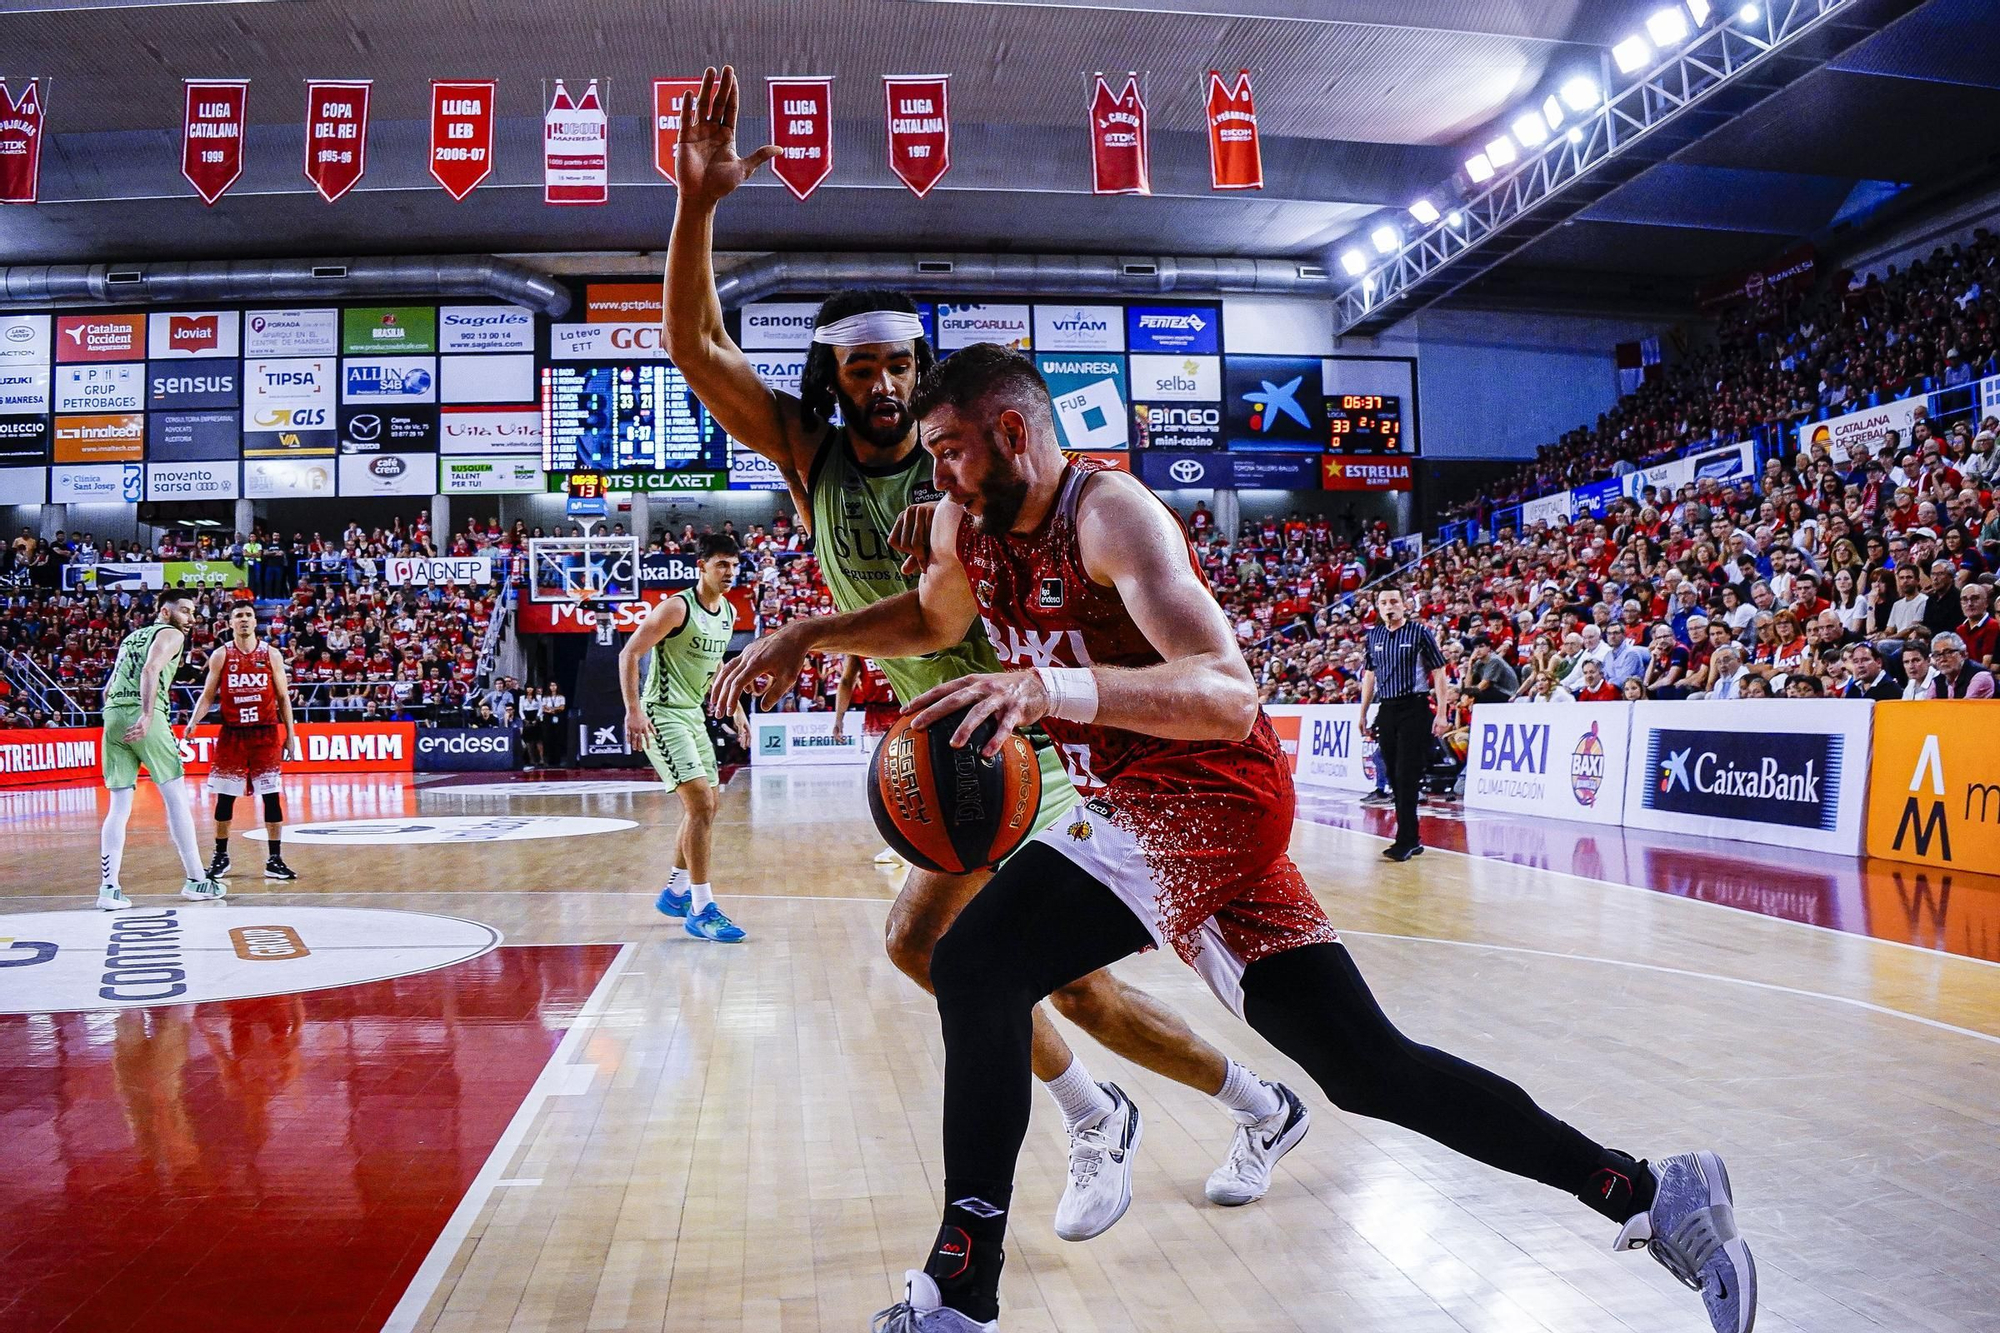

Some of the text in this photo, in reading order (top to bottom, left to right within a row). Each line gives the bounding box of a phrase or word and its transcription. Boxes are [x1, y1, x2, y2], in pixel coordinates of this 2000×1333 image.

[21, 103, 35, 114] 10
[199, 103, 230, 118] LLIGA
[322, 103, 352, 118] COPA
[442, 100, 481, 115] LLIGA
[784, 100, 817, 115] LLIGA
[900, 99, 932, 114] LLIGA
[190, 122, 238, 138] CATALANA
[315, 123, 356, 138] DEL REI
[448, 123, 474, 138] LEB
[788, 120, 813, 135] ACB
[892, 118, 943, 134] CATALANA
[3, 141, 27, 149] TDK
[784, 146, 821, 159] 1997-98
[907, 145, 930, 158] 1997
[201, 151, 224, 163] 1999
[435, 147, 486, 161] 2006-07
[444, 314, 529, 327] Sagalés
[1053, 321, 1106, 330] VITAM
[87, 324, 132, 334] Catalana
[174, 328, 212, 340] Joviat
[87, 334, 131, 344] Occident
[572, 342, 592, 352] ETT
[154, 375, 233, 394] sensus
[265, 373, 315, 386] TIPSA
[1156, 376, 1196, 391] selba
[84, 385, 116, 395] GRUP
[5, 396, 44, 404] MANRESA
[63, 397, 136, 408] PETROBAGES
[1060, 395, 1087, 412] FUB
[1343, 395, 1382, 409] 06:37
[292, 409, 325, 426] GLS
[1332, 417, 1399, 434] 33 2 21
[1834, 414, 1891, 437] CATALANA
[1387, 438, 1396, 448] 2
[377, 457, 398, 467] café
[451, 464, 493, 472] BUSQUEM
[154, 470, 212, 481] movento
[374, 466, 400, 474] crem
[1345, 464, 1409, 478] ESTRELLA
[154, 482, 191, 492] sarsa
[647, 473, 715, 488] CLARET
[580, 485, 596, 497] 13
[415, 561, 482, 580] AIGNEP
[227, 672, 268, 688] BAXI
[239, 706, 259, 723] 55
[418, 733, 509, 753] endesa
[792, 736, 807, 746] WE
[1312, 720, 1350, 758] BAXI
[56, 739, 95, 769] DAMM
[310, 734, 403, 761] DAMM
[1480, 723, 1550, 774] BAXI
[1572, 754, 1604, 778] BAXI
[1694, 751, 1820, 803] CaixaBank
[1477, 778, 1546, 800] CLIMATIZACIÓN
[1088, 803, 1108, 815] acb
[243, 929, 297, 956] GROUP
[99, 909, 187, 1001] CONTROL
